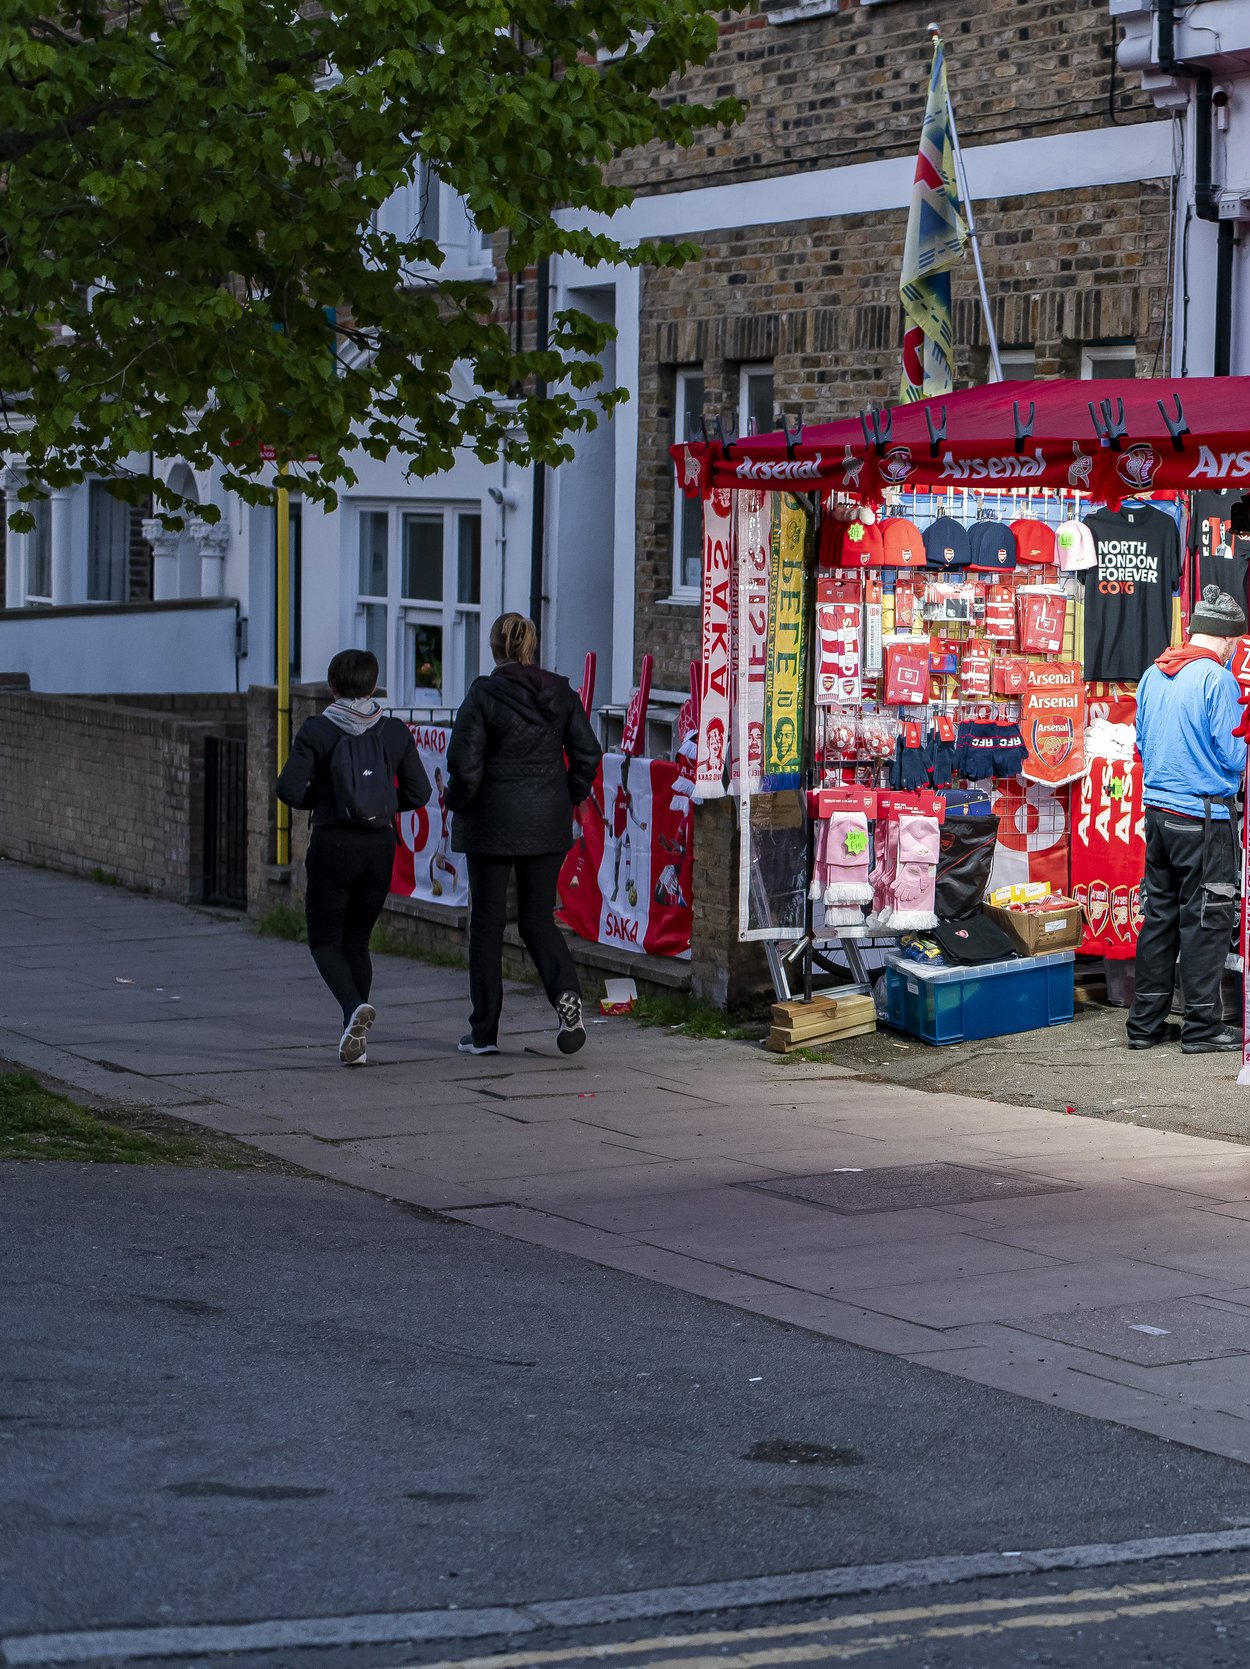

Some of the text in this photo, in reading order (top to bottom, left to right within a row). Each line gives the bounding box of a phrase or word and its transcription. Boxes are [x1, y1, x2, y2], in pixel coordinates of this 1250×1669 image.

[735, 453, 822, 481] Arsenal
[938, 448, 1046, 479] Arsenal
[1098, 541, 1148, 555] NORTH
[1098, 555, 1159, 570] LONDON
[1098, 568, 1159, 584] FOREVER
[1098, 581, 1135, 595] COYG
[1027, 670, 1075, 685] Arsenal
[1028, 694, 1079, 709] Arsenal
[1037, 722, 1069, 733] Arsenal
[972, 738, 993, 747] AFC
[999, 736, 1021, 747] AFC
[605, 912, 639, 945] SAKA
